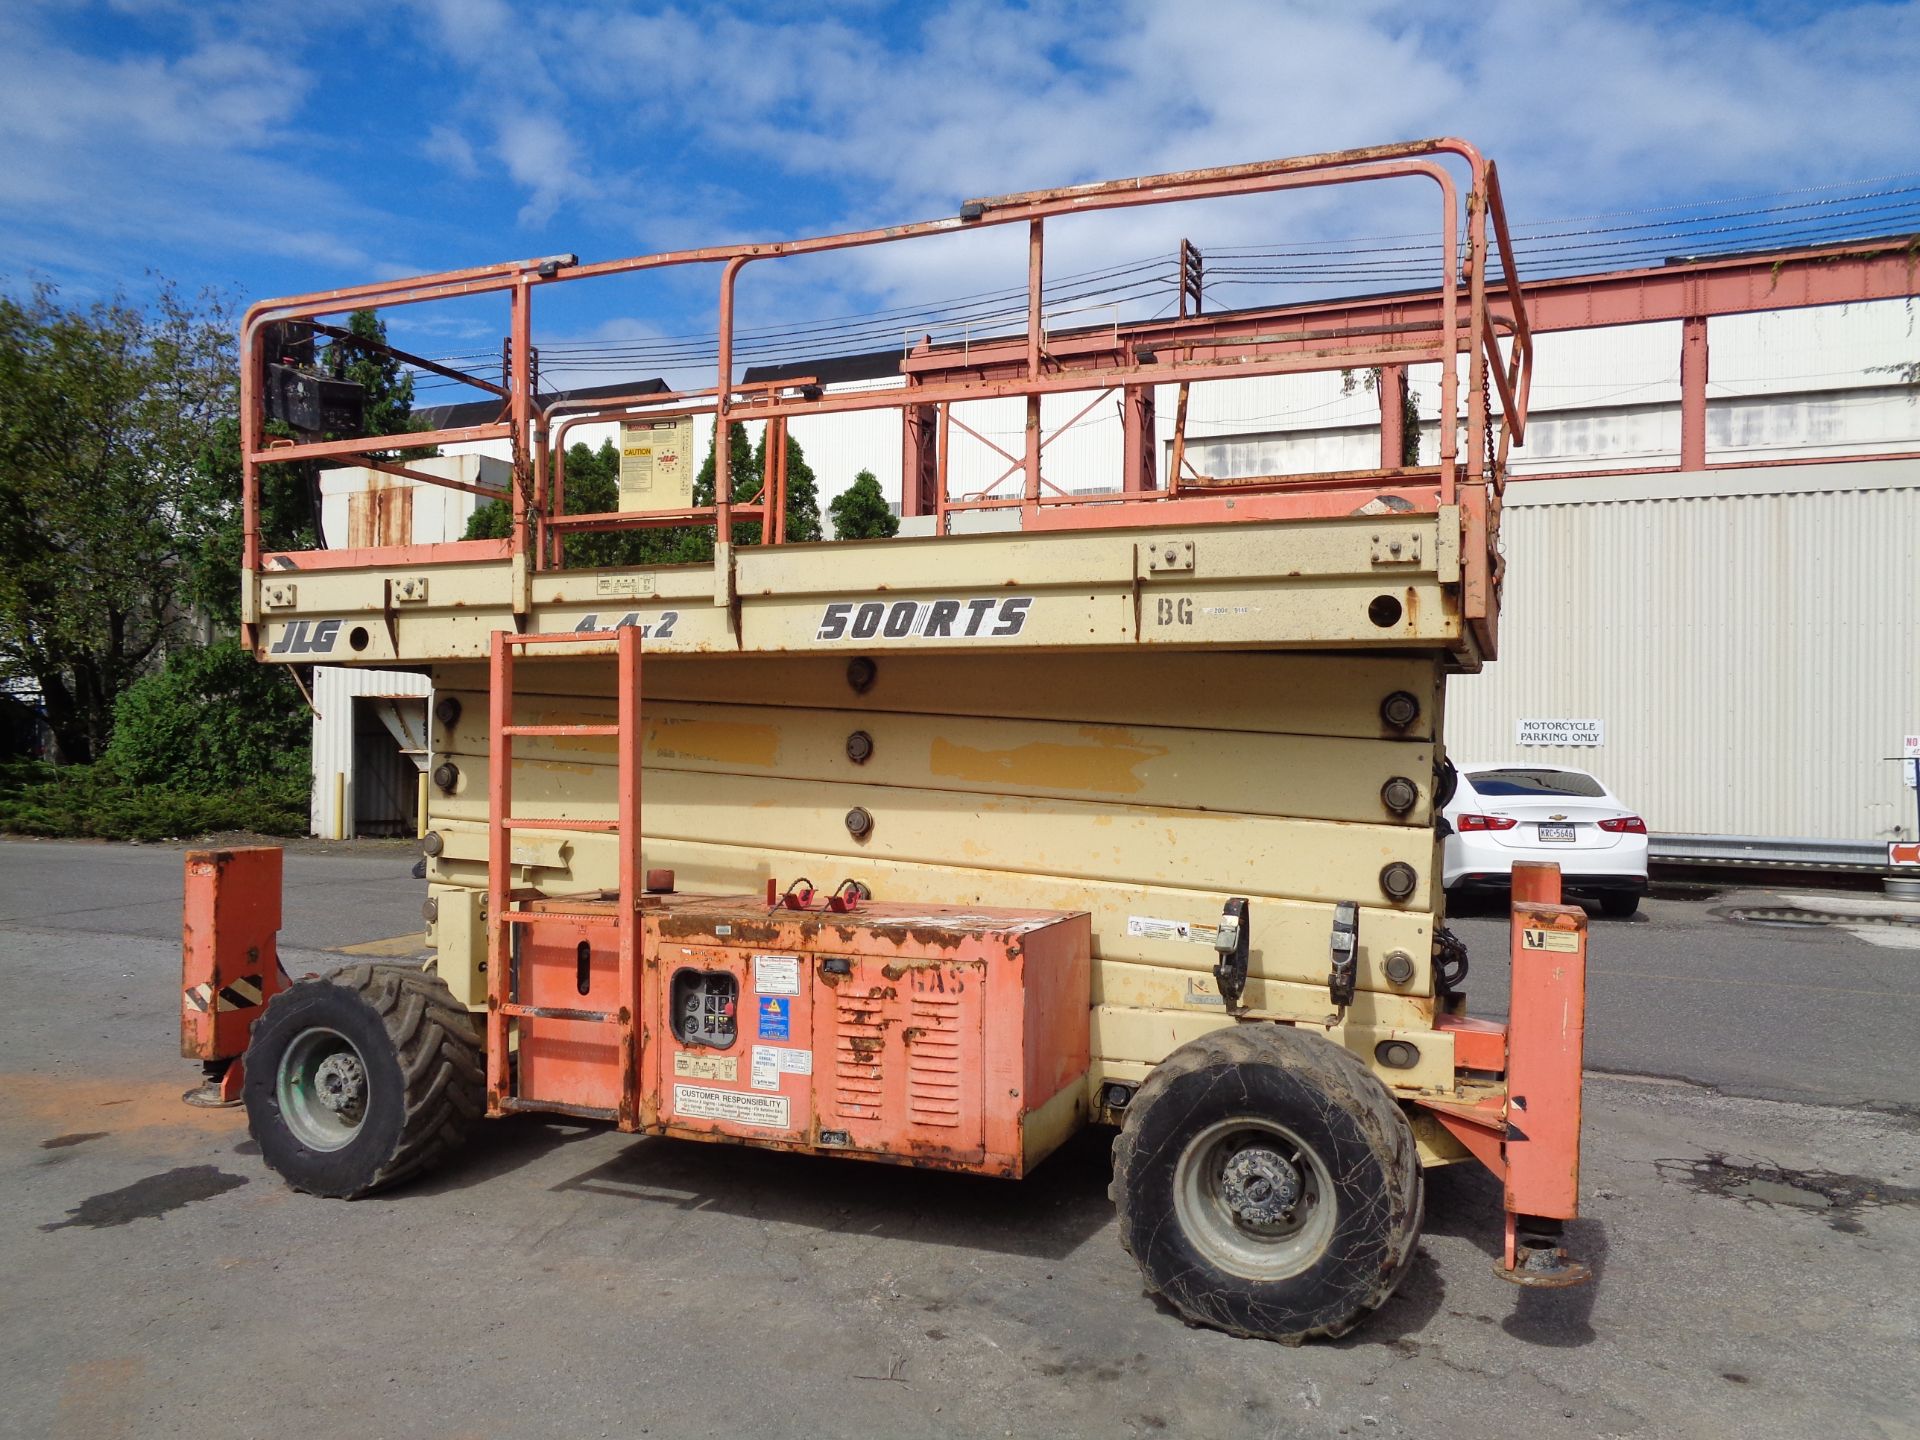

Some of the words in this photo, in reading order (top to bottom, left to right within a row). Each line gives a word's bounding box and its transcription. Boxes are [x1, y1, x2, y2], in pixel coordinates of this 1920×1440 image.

[816, 602, 919, 640] 500
[923, 598, 1033, 637] RTS
[1157, 598, 1193, 625] BG
[271, 620, 343, 653] JLG
[1523, 722, 1596, 731] MOTORCYCLE
[1520, 733, 1568, 742] PARKING
[1572, 733, 1600, 742] ONLY
[1906, 737, 1918, 747] NO
[681, 1089, 720, 1101] CUSTOMER
[722, 1095, 781, 1109] RESPONSIBILITY
